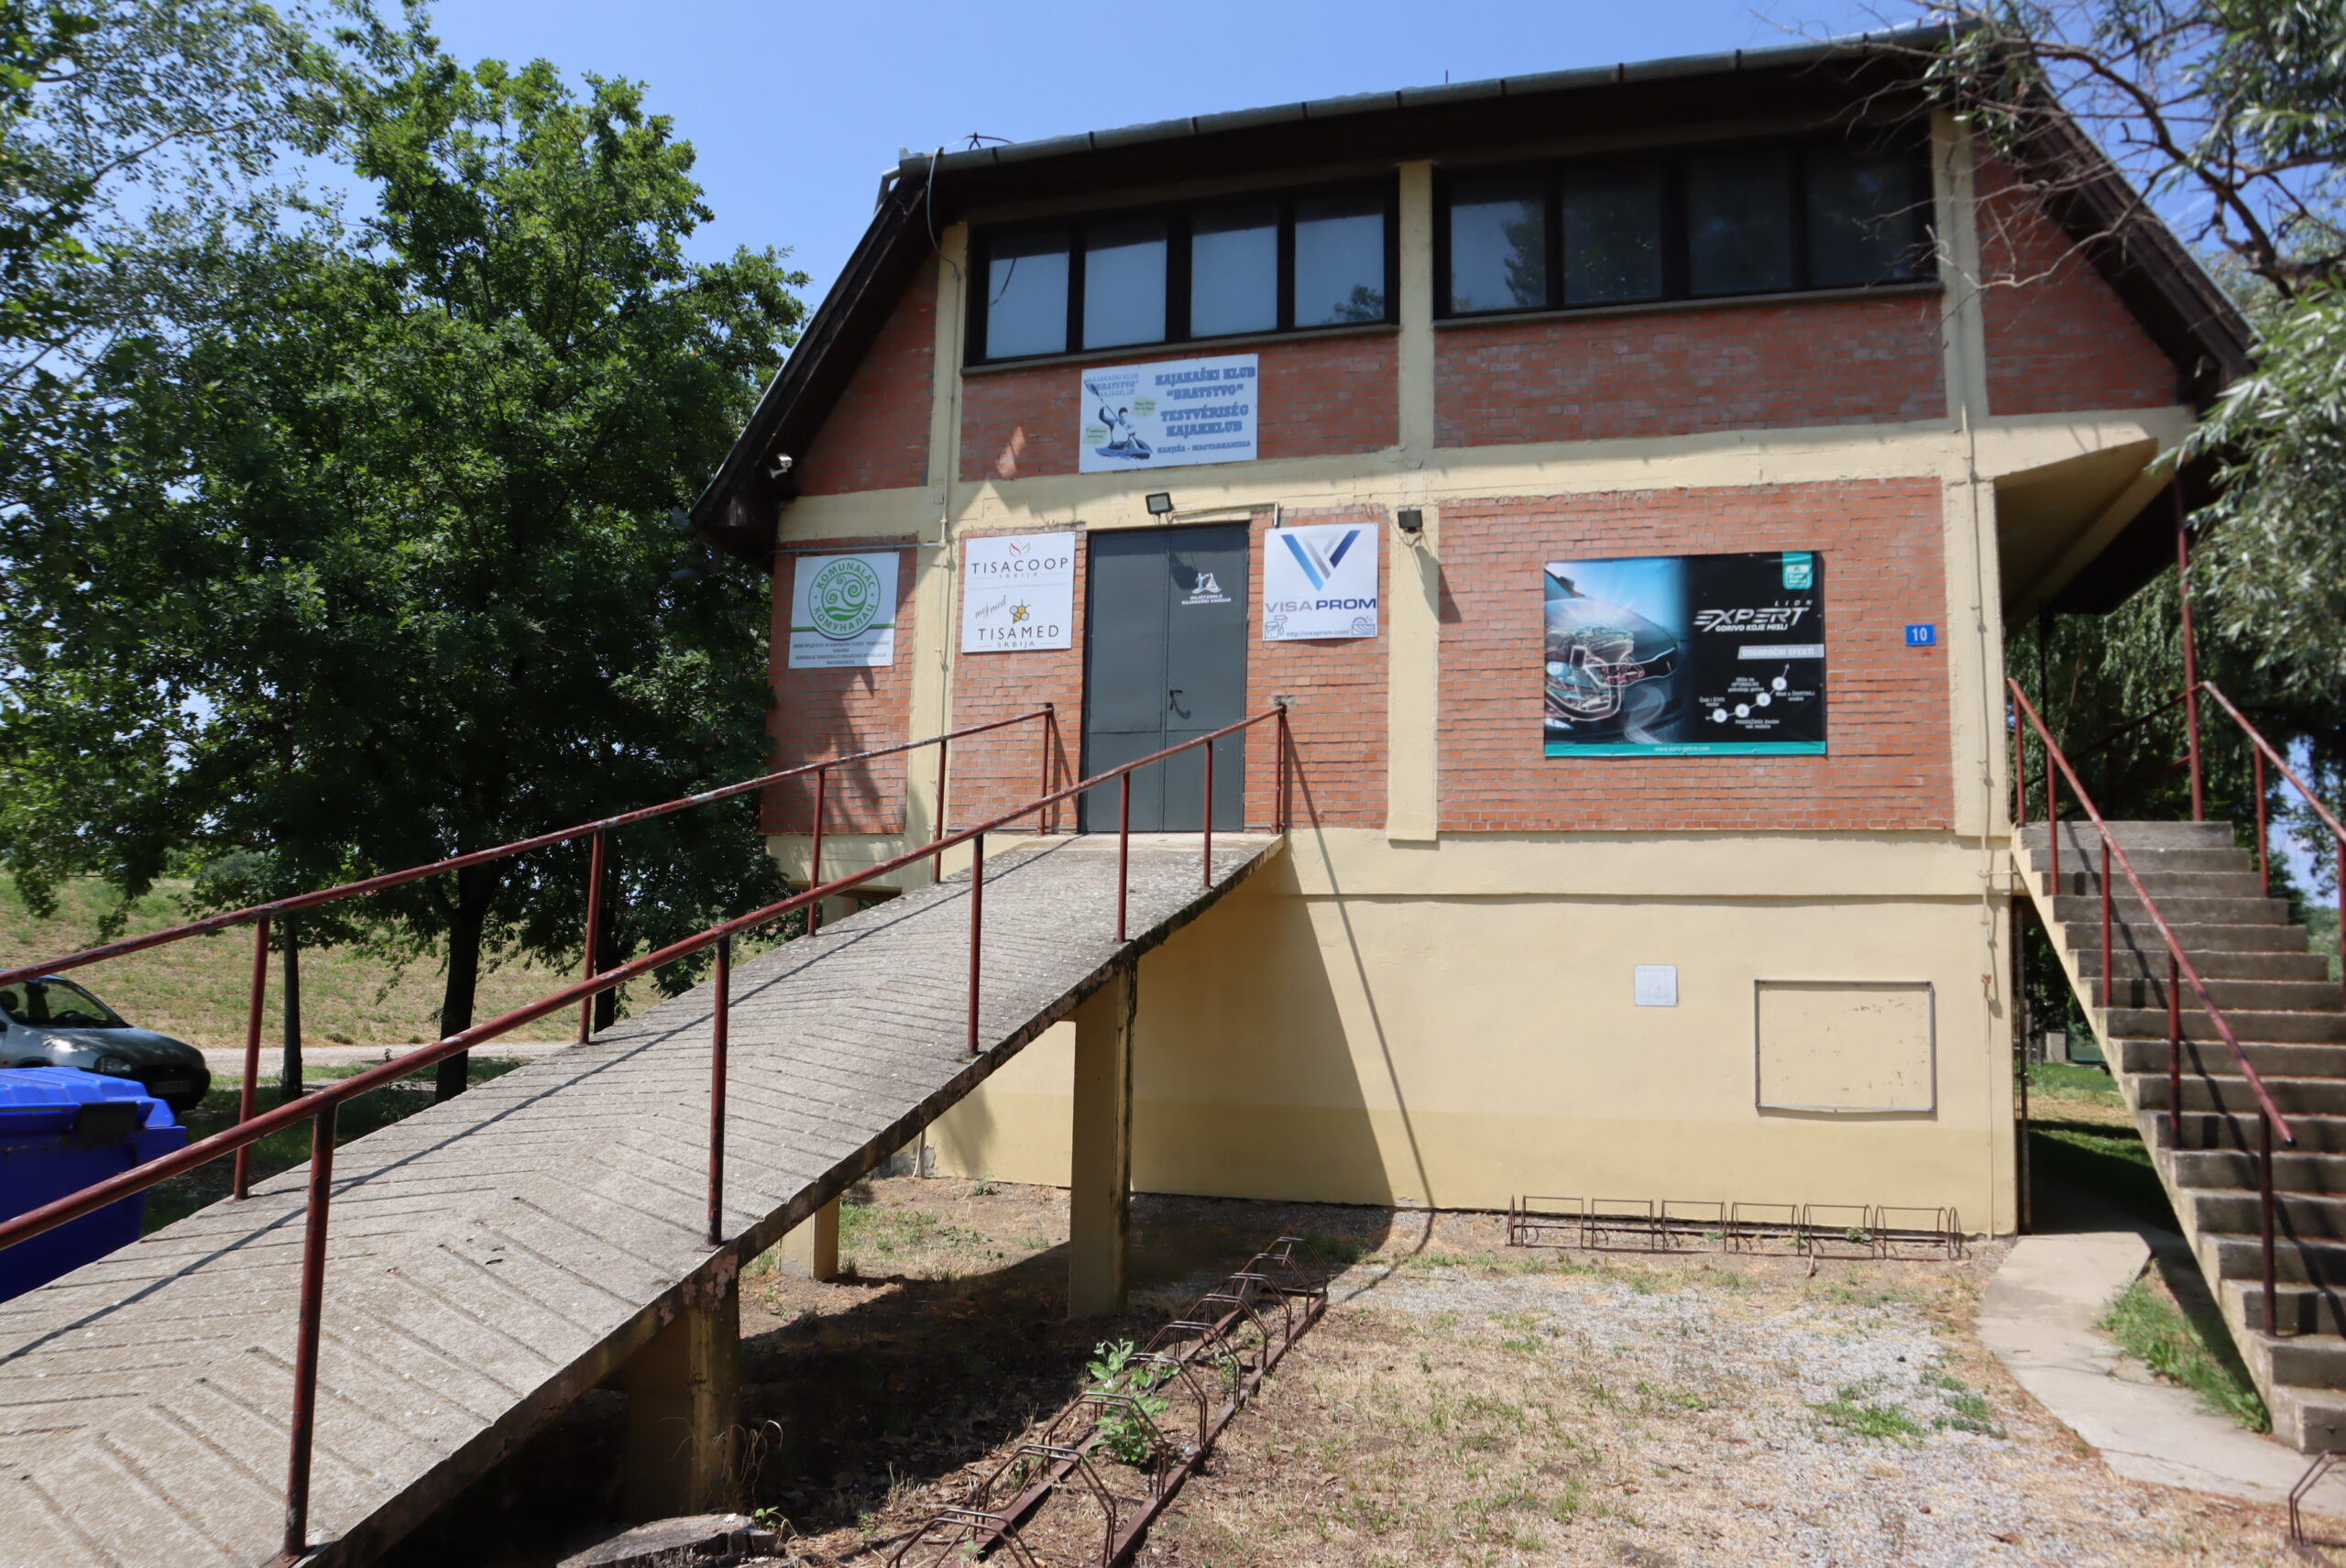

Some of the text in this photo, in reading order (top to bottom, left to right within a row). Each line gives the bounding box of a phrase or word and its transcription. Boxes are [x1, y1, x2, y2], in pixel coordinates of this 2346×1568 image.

[1155, 366, 1255, 387] KAJAKAŠKI KLUB
[1160, 401, 1249, 422] TESTVÉRISÉG
[1166, 421, 1243, 439] KAJAKKLUB
[817, 562, 876, 589] KOMUNALAC
[971, 557, 1069, 575] TISACOOP
[814, 604, 876, 631] КОМУНАЛАЦ
[1693, 607, 1810, 632] EXPERT
[978, 624, 1059, 641] TISAMED
[1715, 623, 1788, 632] GORIVO KOJE MISLI
[1913, 627, 1928, 641] 10
